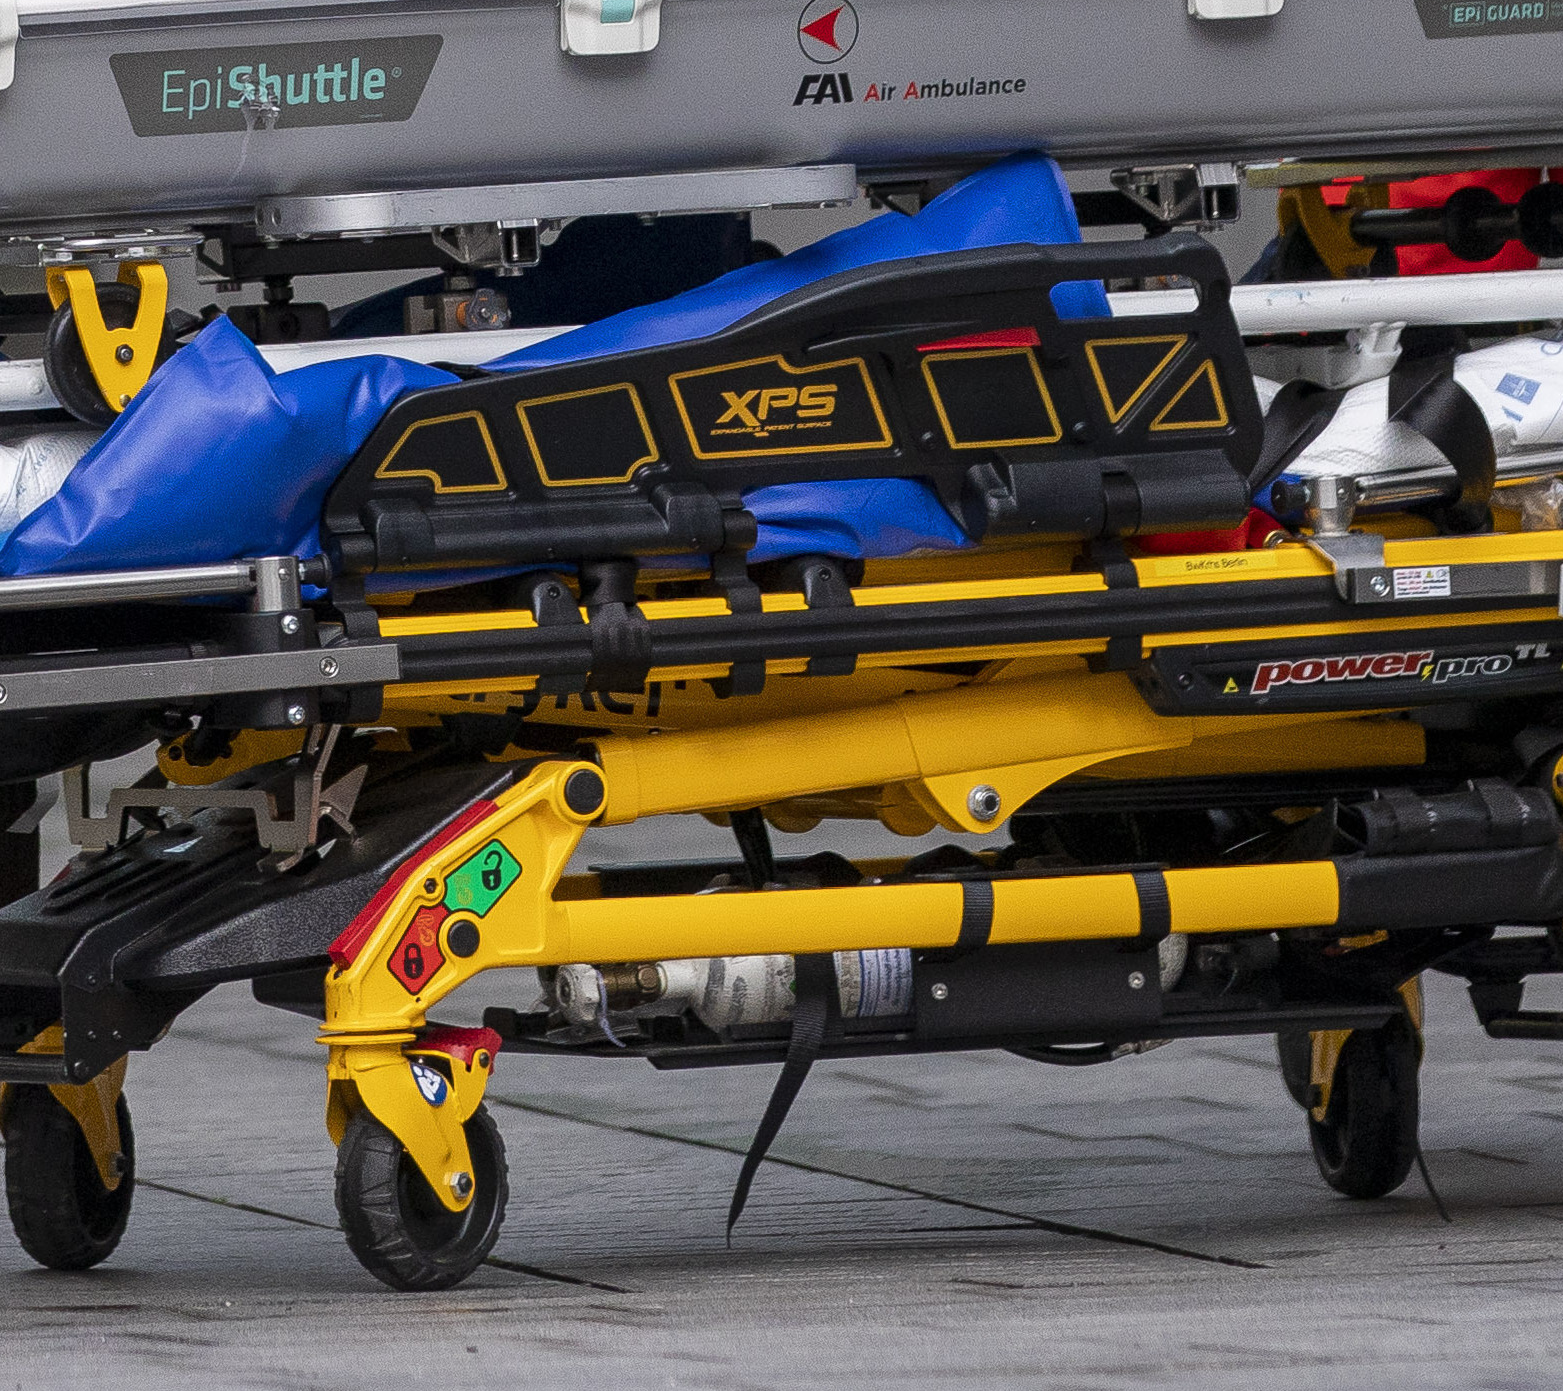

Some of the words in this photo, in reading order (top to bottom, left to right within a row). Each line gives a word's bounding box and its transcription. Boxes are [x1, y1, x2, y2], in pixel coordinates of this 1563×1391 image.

[1486, 1, 1545, 22] GUARD
[792, 72, 855, 107] FAI
[863, 81, 897, 103] Air
[903, 76, 1028, 102] Ambulance
[715, 384, 838, 427] XPS
[1250, 650, 1434, 695] power
[1432, 654, 1513, 684] pro
